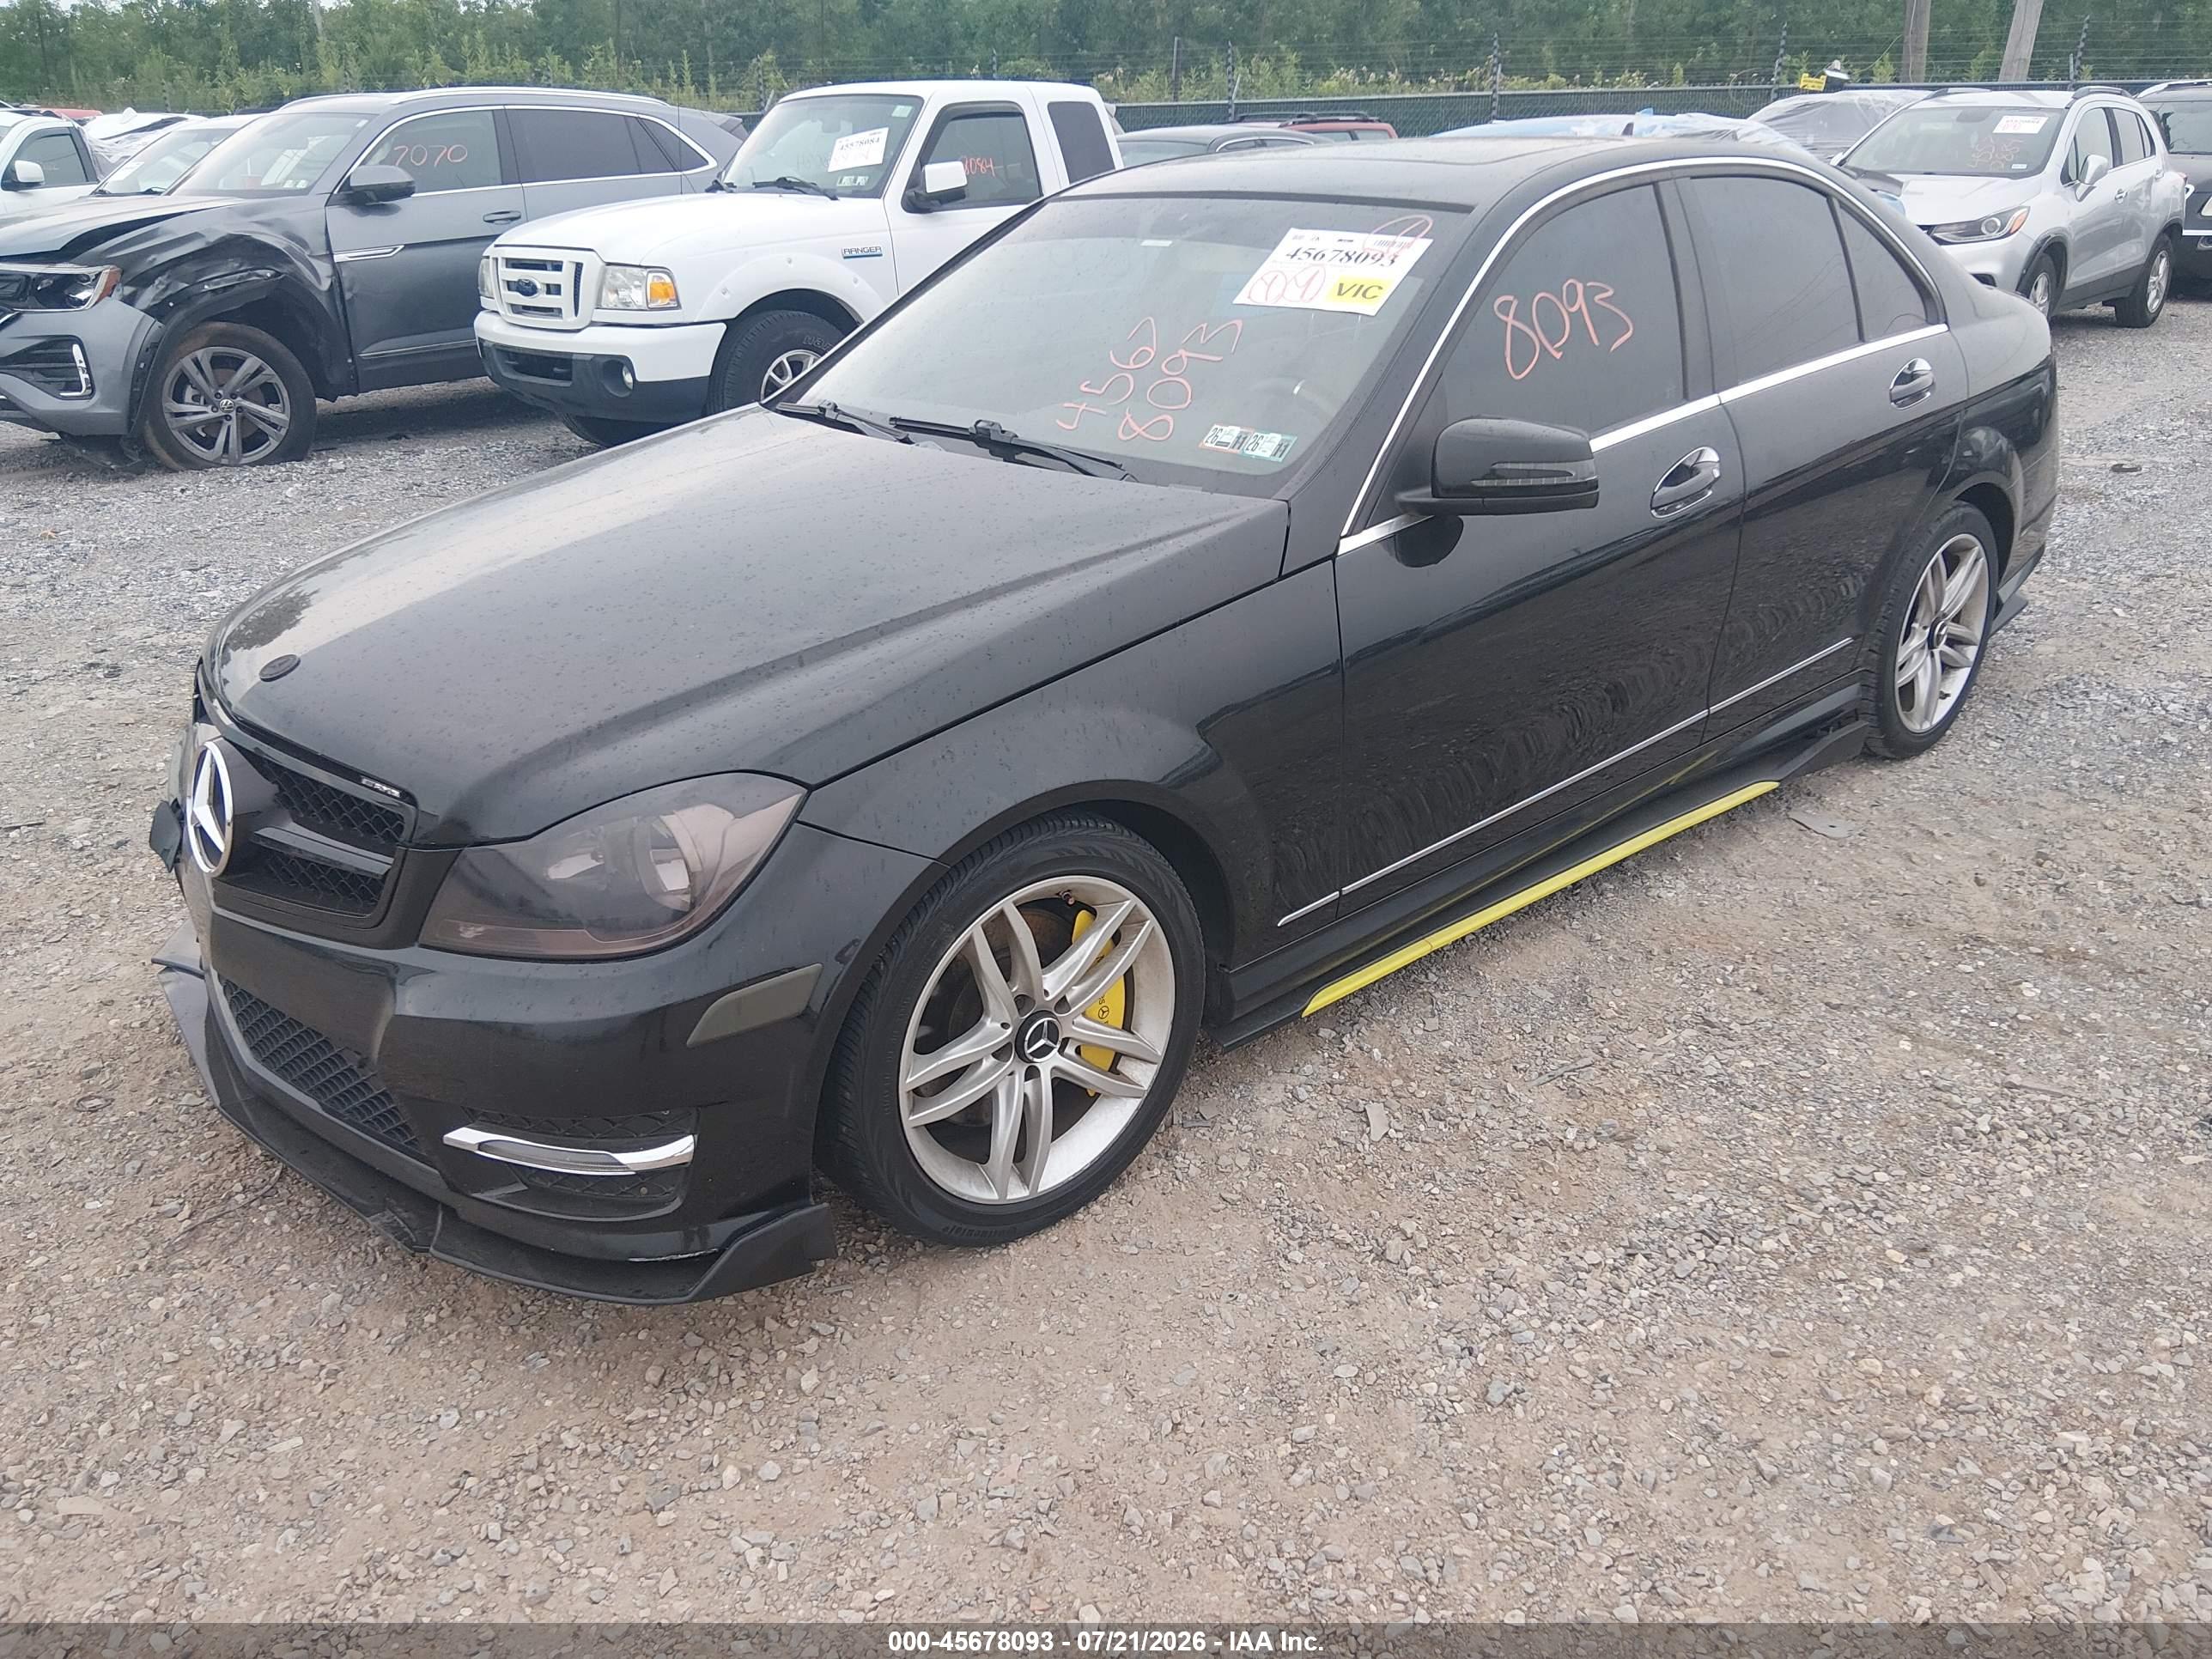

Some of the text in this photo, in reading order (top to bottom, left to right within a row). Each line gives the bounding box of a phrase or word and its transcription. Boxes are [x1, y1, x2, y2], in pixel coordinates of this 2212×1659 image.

[394, 144, 468, 167] 7070
[843, 246, 882, 255] RANGER
[1285, 246, 1399, 267] 45678093
[1336, 283, 1384, 300] VIC
[1493, 278, 1633, 380] 8093
[1118, 319, 1243, 441] 8093
[1205, 427, 1223, 444] 26
[1246, 434, 1265, 453] 26
